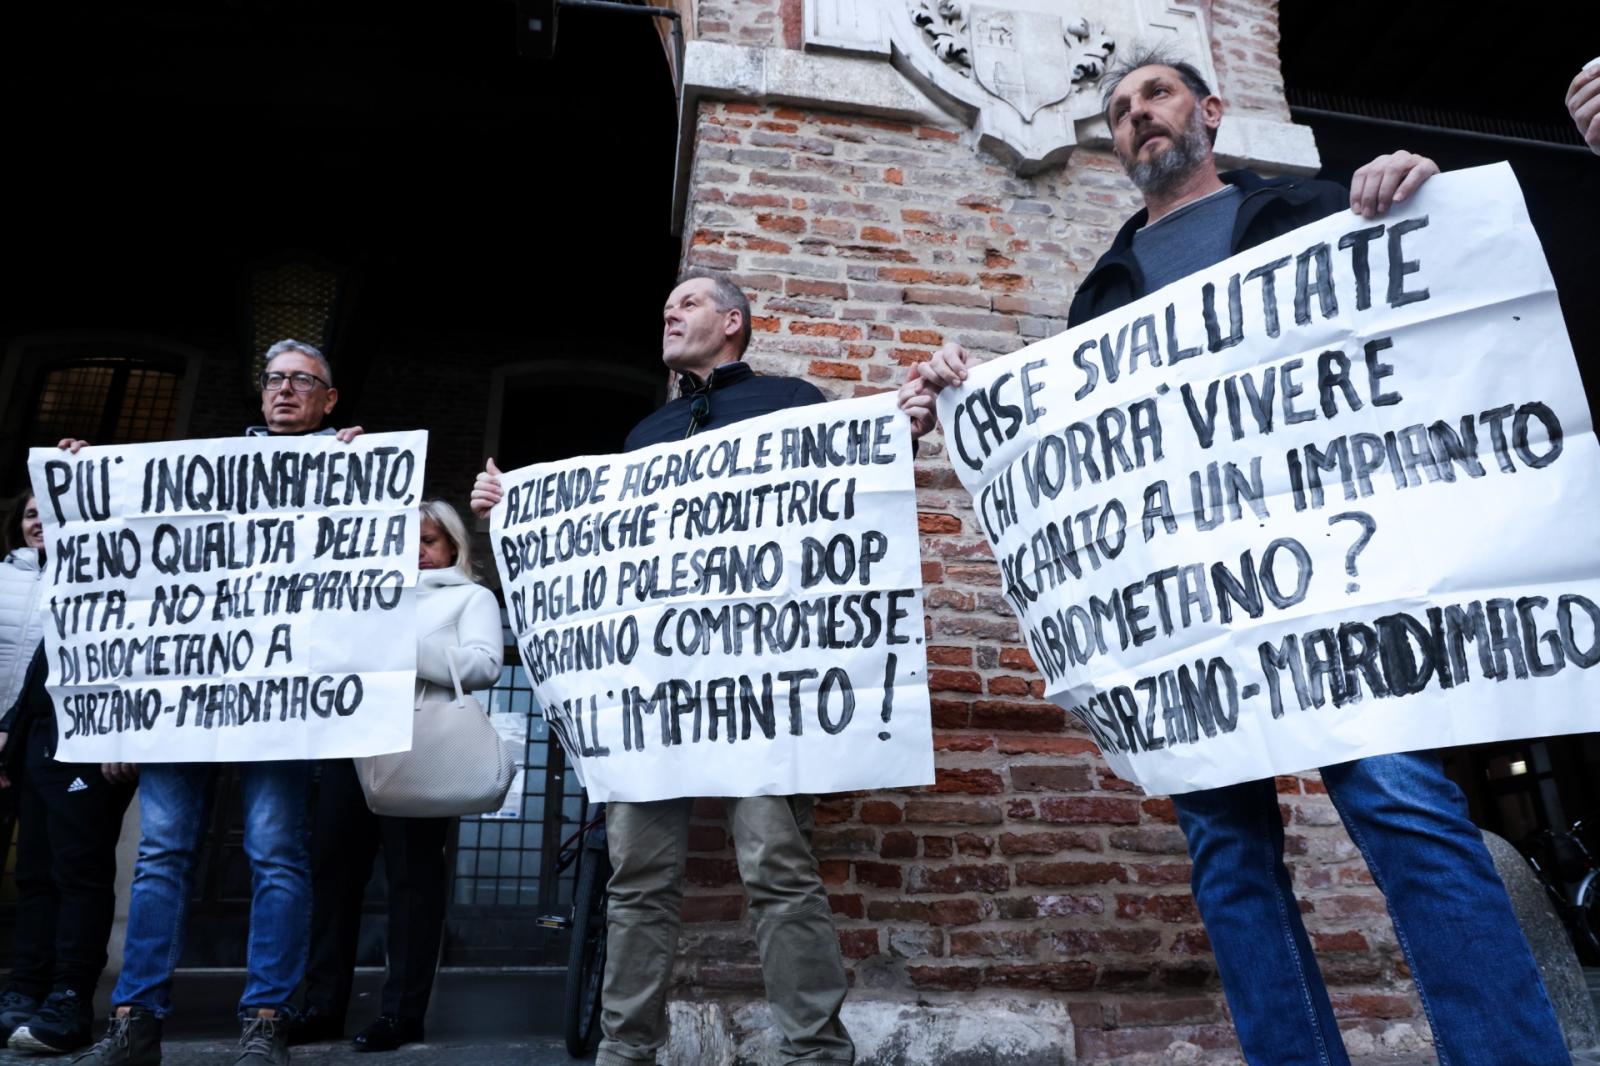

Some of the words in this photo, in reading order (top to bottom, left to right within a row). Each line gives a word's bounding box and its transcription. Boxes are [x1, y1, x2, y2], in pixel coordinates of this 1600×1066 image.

[954, 358, 1048, 473] CASE
[1072, 214, 1430, 401] SVALUTATE
[141, 446, 415, 514] INQUINAMENTO,
[502, 464, 611, 529] AZIENDE
[617, 432, 773, 501] AGRICOLE
[781, 415, 897, 471] ANCHE
[981, 463, 1018, 545] CHI
[1180, 336, 1403, 449] VIVERE
[1142, 479, 1178, 542] A
[1189, 456, 1271, 532] UN
[1286, 401, 1564, 512] IMPIANTO
[54, 527, 141, 586] MENO
[313, 514, 407, 560] DELLA
[501, 502, 660, 582] BIOLOGICHE
[668, 478, 857, 541] PRODUTTRICI
[50, 589, 135, 640] VITA.
[148, 584, 205, 627] NO
[511, 586, 528, 635] DI
[532, 565, 608, 624] AGLIO
[616, 541, 783, 607] POLESANO
[800, 530, 888, 588] DOP
[58, 645, 81, 687] DI
[85, 629, 254, 683] BIOMETANO
[264, 623, 293, 668] A
[523, 614, 639, 687] VERRANNO
[653, 589, 923, 657] COMPROMESSE.
